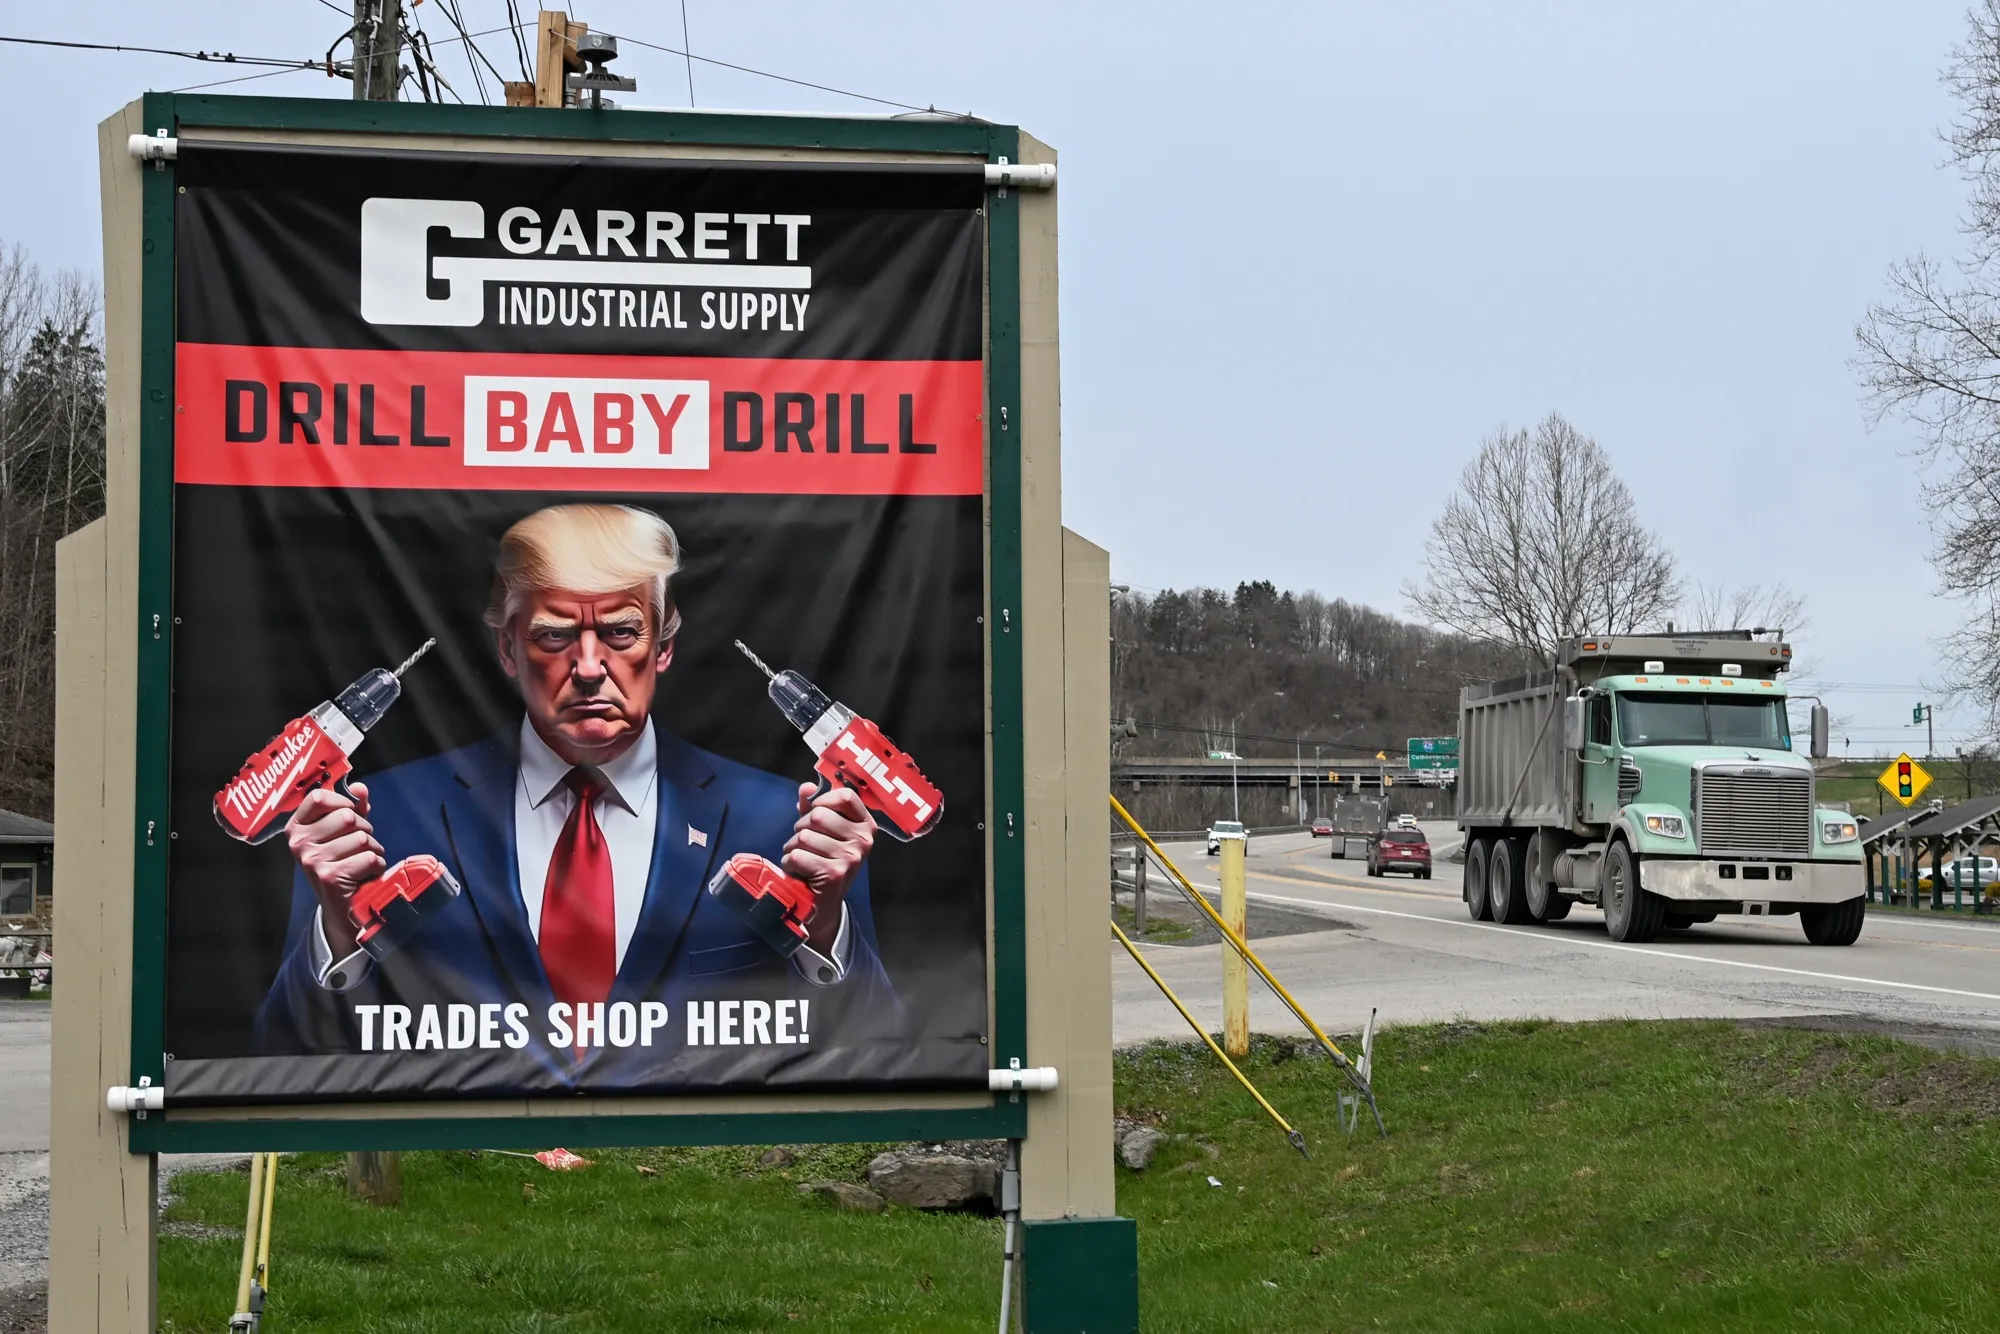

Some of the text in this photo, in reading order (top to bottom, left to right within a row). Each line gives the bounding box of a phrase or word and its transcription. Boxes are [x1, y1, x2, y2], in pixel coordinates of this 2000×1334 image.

[361, 197, 485, 328] G
[497, 206, 812, 261] GARRETT
[498, 285, 812, 332] INDUSTRIAL SUPPLY
[224, 379, 938, 455] DRILL BABY DRILL
[225, 724, 315, 819] Milwaukee
[836, 731, 933, 823] HILTI
[354, 998, 811, 1051] TRADES SHOP HERE!
